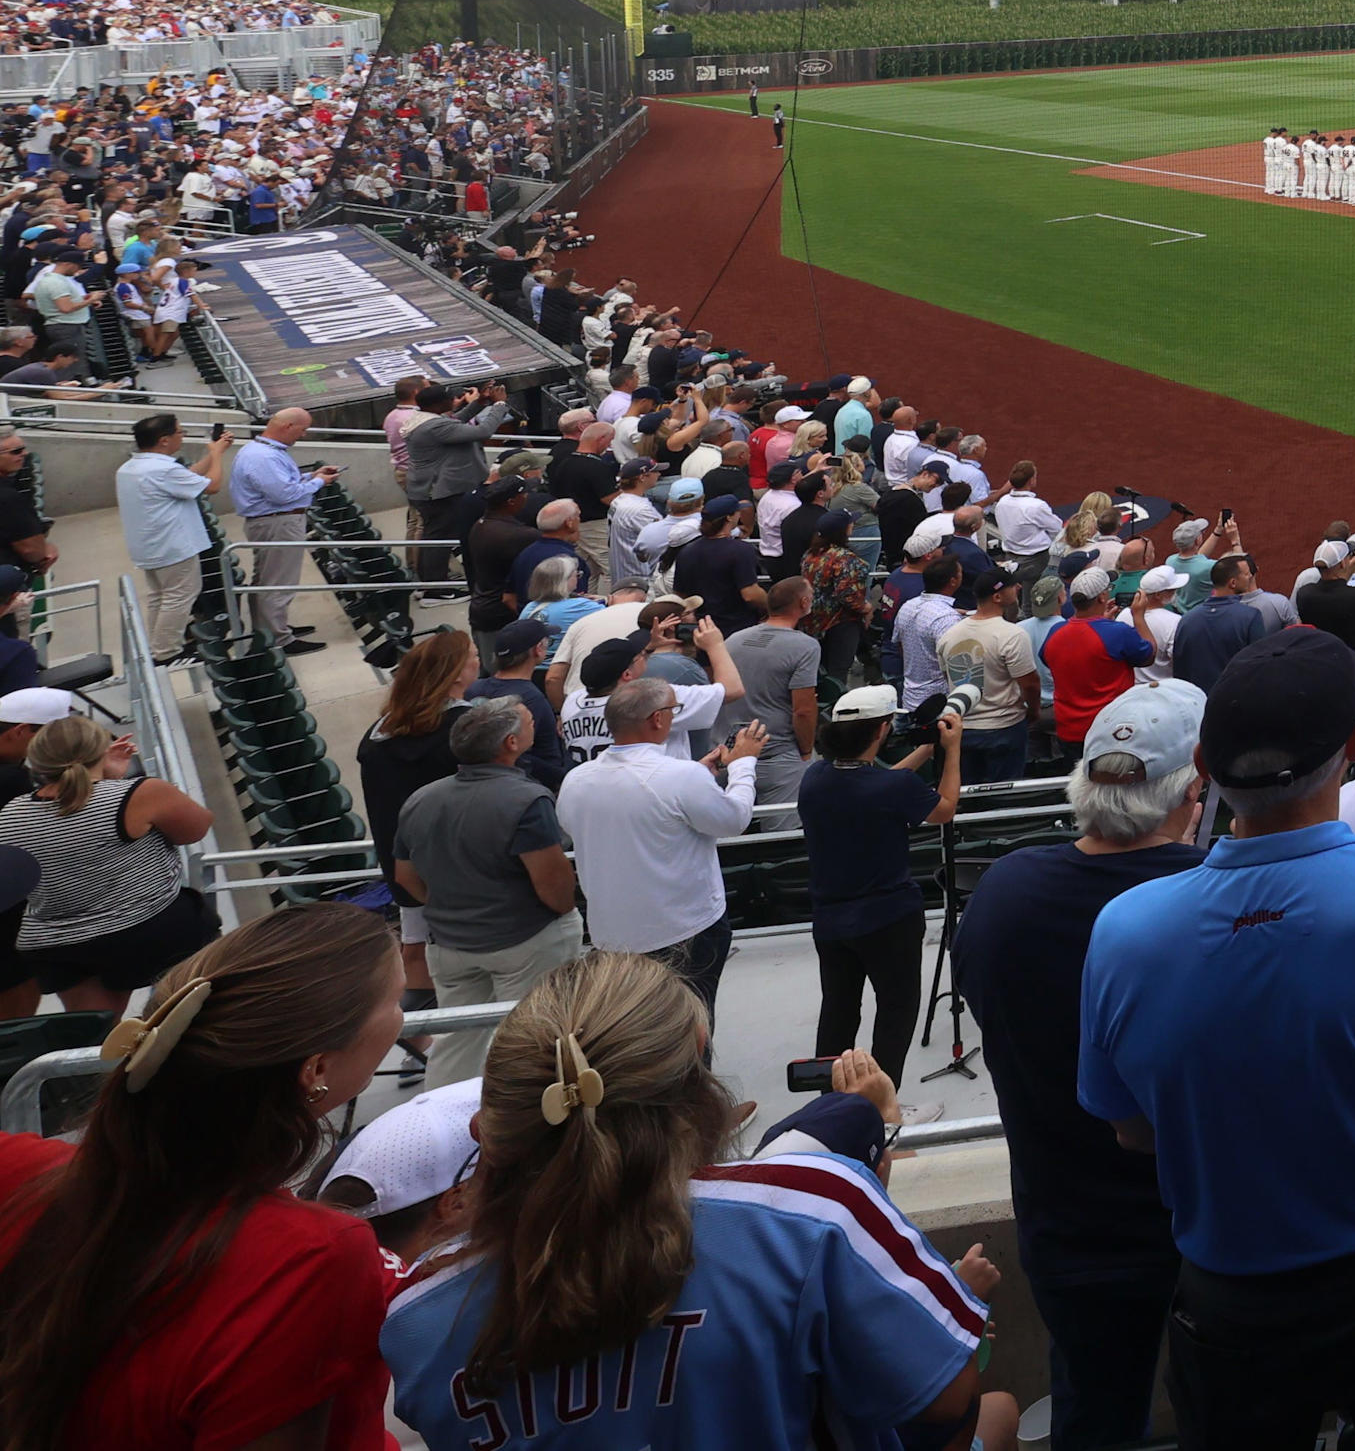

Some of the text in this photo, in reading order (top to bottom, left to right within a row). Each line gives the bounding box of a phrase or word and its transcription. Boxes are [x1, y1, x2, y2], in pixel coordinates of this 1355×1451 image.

[718, 65, 770, 77] BETMGM
[801, 62, 827, 73] Ford
[647, 68, 675, 82] 335
[292, 293, 440, 344] TWINS
[562, 716, 613, 741] FIDRYC
